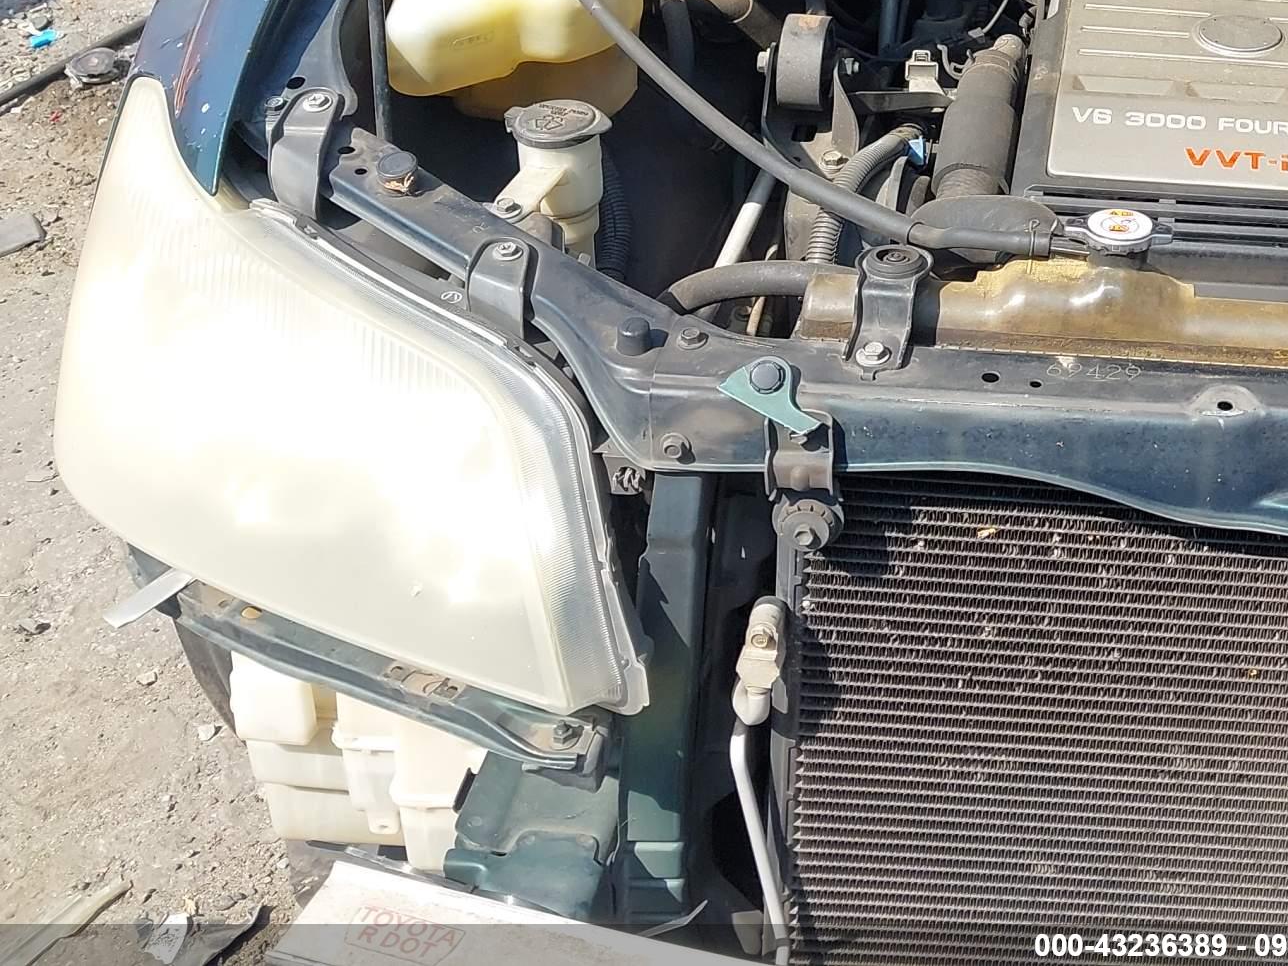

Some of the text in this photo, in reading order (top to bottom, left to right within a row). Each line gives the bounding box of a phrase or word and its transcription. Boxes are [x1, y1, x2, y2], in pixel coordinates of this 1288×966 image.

[1071, 106, 1113, 124] V6
[1125, 110, 1206, 130] 3000
[1046, 362, 1142, 381] 69429
[360, 906, 457, 947] TOYOTA
[357, 925, 438, 958] R DOT
